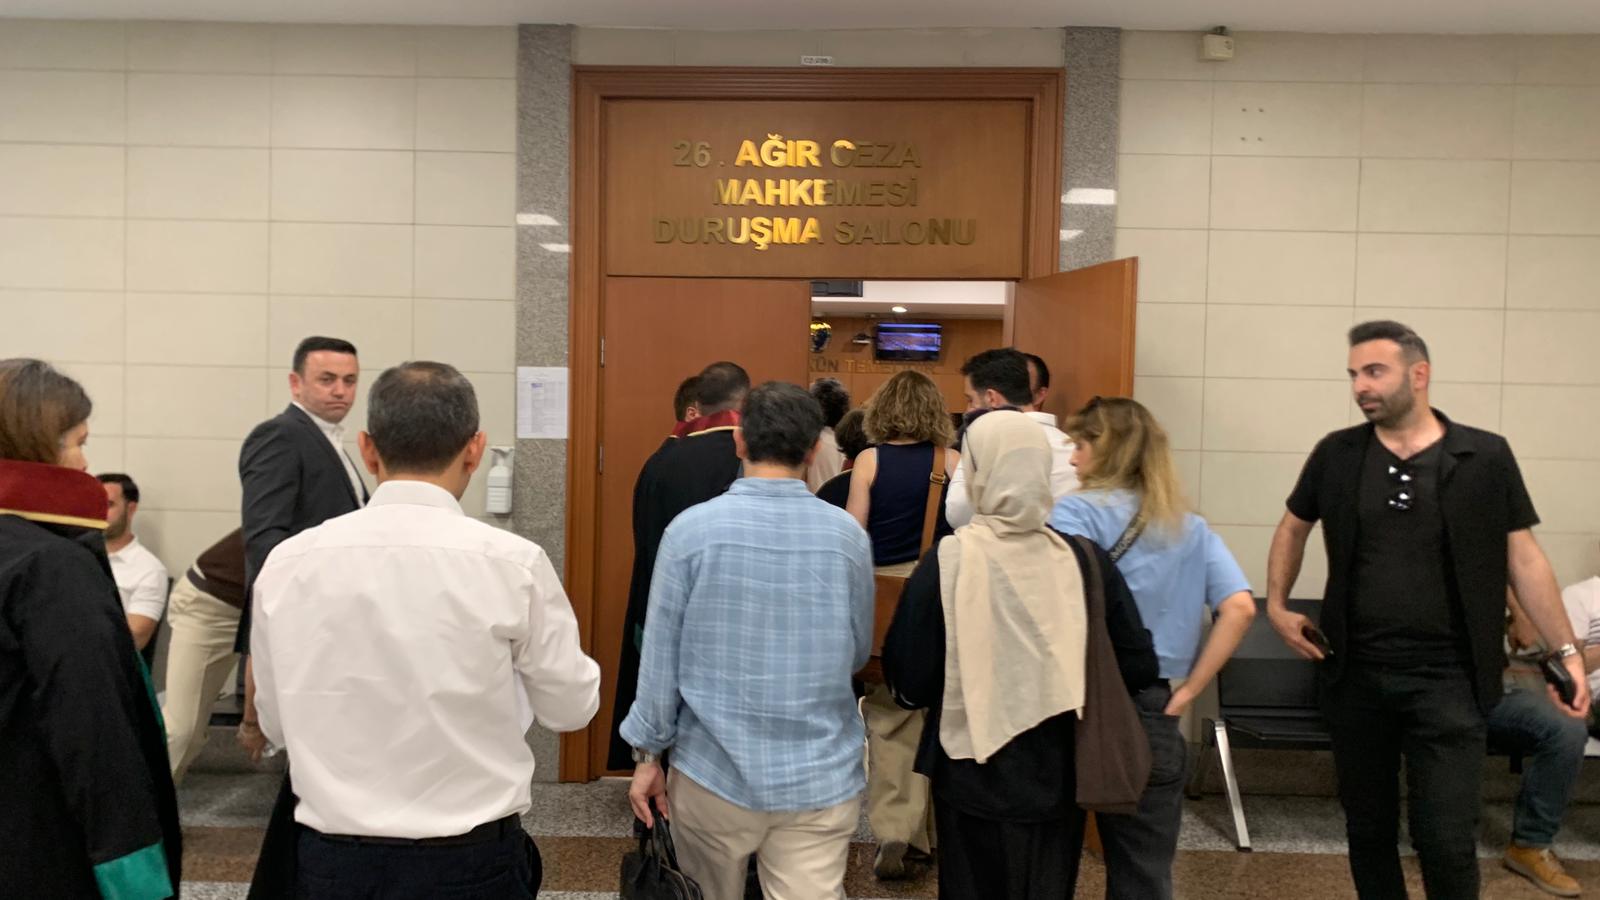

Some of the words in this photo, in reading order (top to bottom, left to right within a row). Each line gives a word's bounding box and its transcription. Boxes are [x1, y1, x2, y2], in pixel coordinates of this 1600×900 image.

[735, 133, 822, 168] AĞIR
[830, 139, 921, 168] CEZA
[712, 177, 918, 207] MAHKEMESİ
[654, 216, 825, 250] DURUŞMA
[834, 218, 977, 245] SALONU
